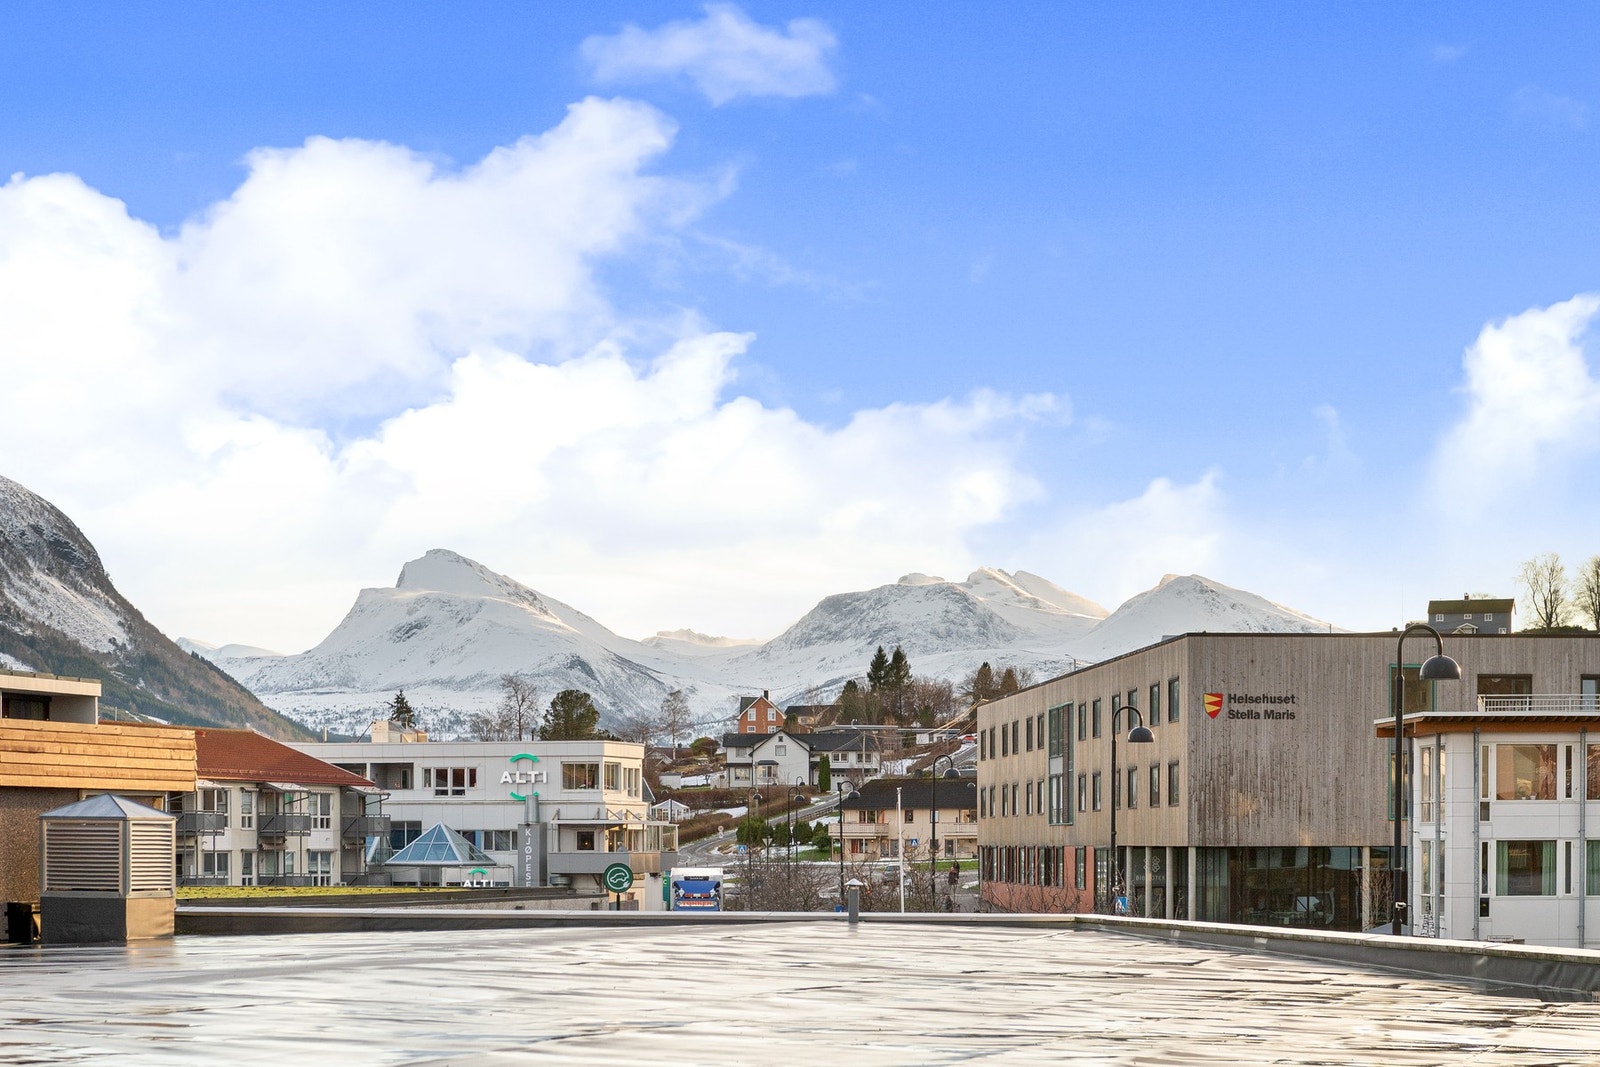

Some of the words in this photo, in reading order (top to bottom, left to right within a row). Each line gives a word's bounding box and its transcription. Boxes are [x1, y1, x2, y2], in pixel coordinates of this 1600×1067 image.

[1228, 693, 1296, 704] Helsehuset
[1228, 709, 1261, 720] Stella
[1263, 709, 1296, 720] Maris
[500, 770, 547, 784] ALTI
[463, 879, 493, 888] ALTI
